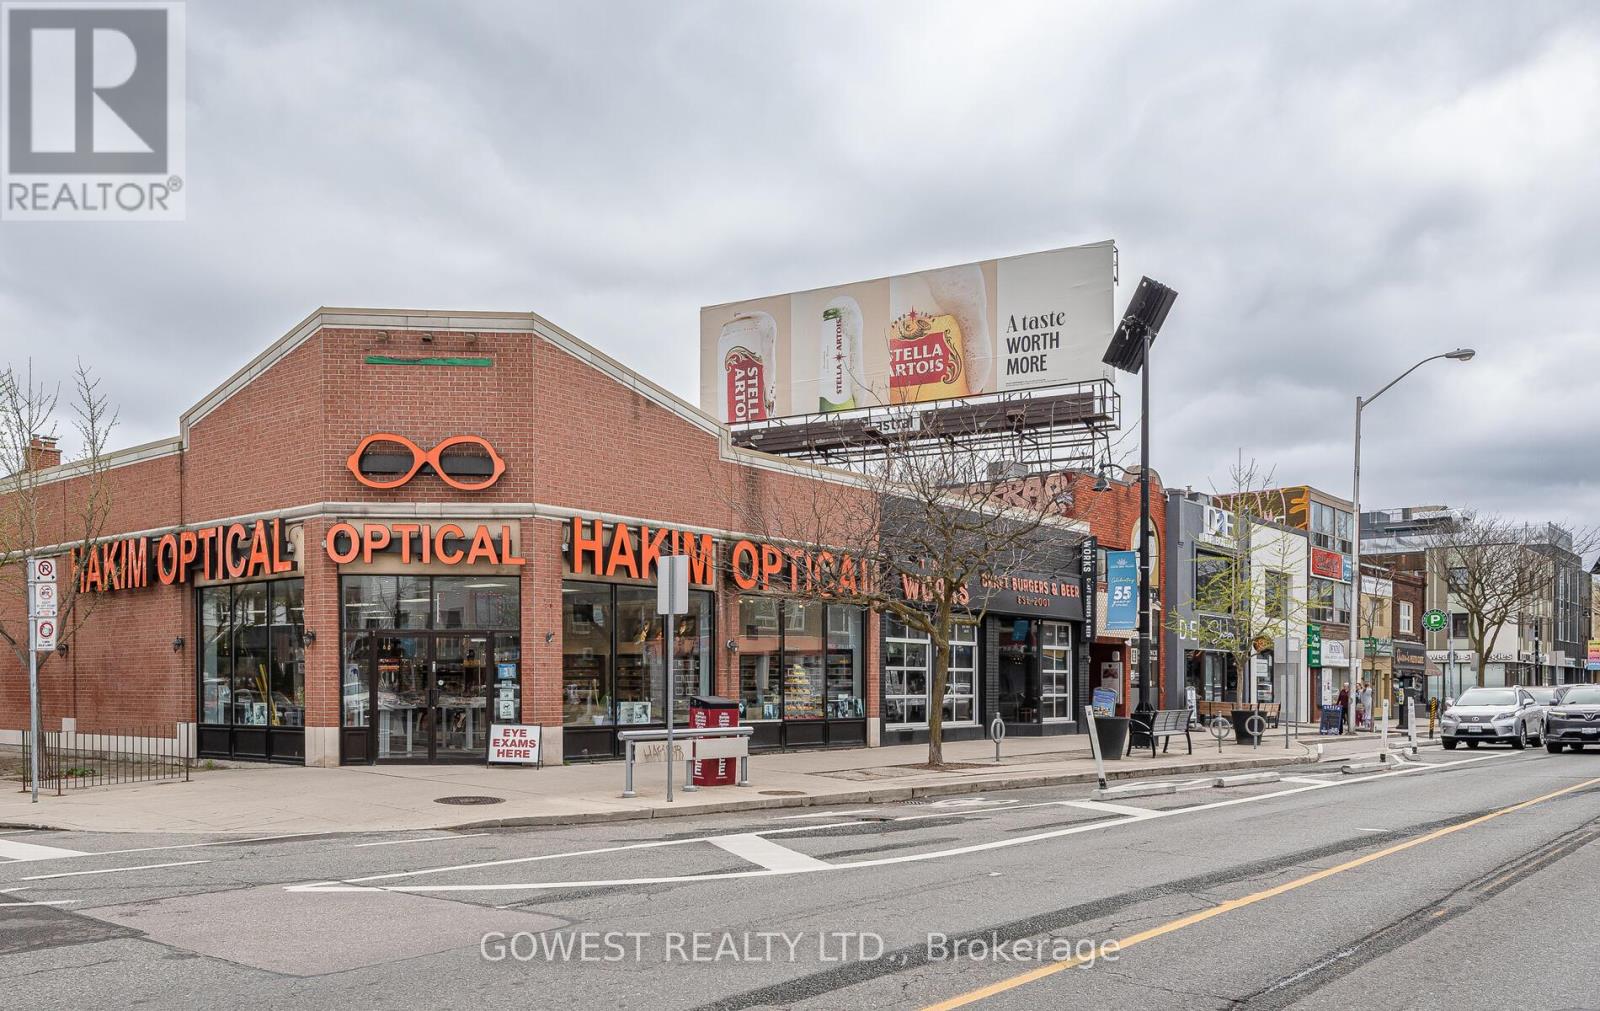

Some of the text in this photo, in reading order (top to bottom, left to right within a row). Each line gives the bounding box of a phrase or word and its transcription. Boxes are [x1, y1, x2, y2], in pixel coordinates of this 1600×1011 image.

[1006, 311, 1065, 333] A taste
[1006, 332, 1060, 354] WORTH
[1006, 354, 1047, 375] MORE
[326, 523, 527, 565] OPTICAL
[572, 516, 713, 586] HAKIM
[70, 517, 293, 593] HAKIM OPTICAL
[1082, 540, 1092, 572] WORKS
[1012, 577, 1050, 595] BURGERS
[1051, 582, 1058, 596] &
[1061, 583, 1080, 598] BEER
[1113, 586, 1132, 600] 55
[492, 738, 537, 748] EXAMS
[503, 728, 527, 738] EYE
[496, 748, 530, 758] HERE
